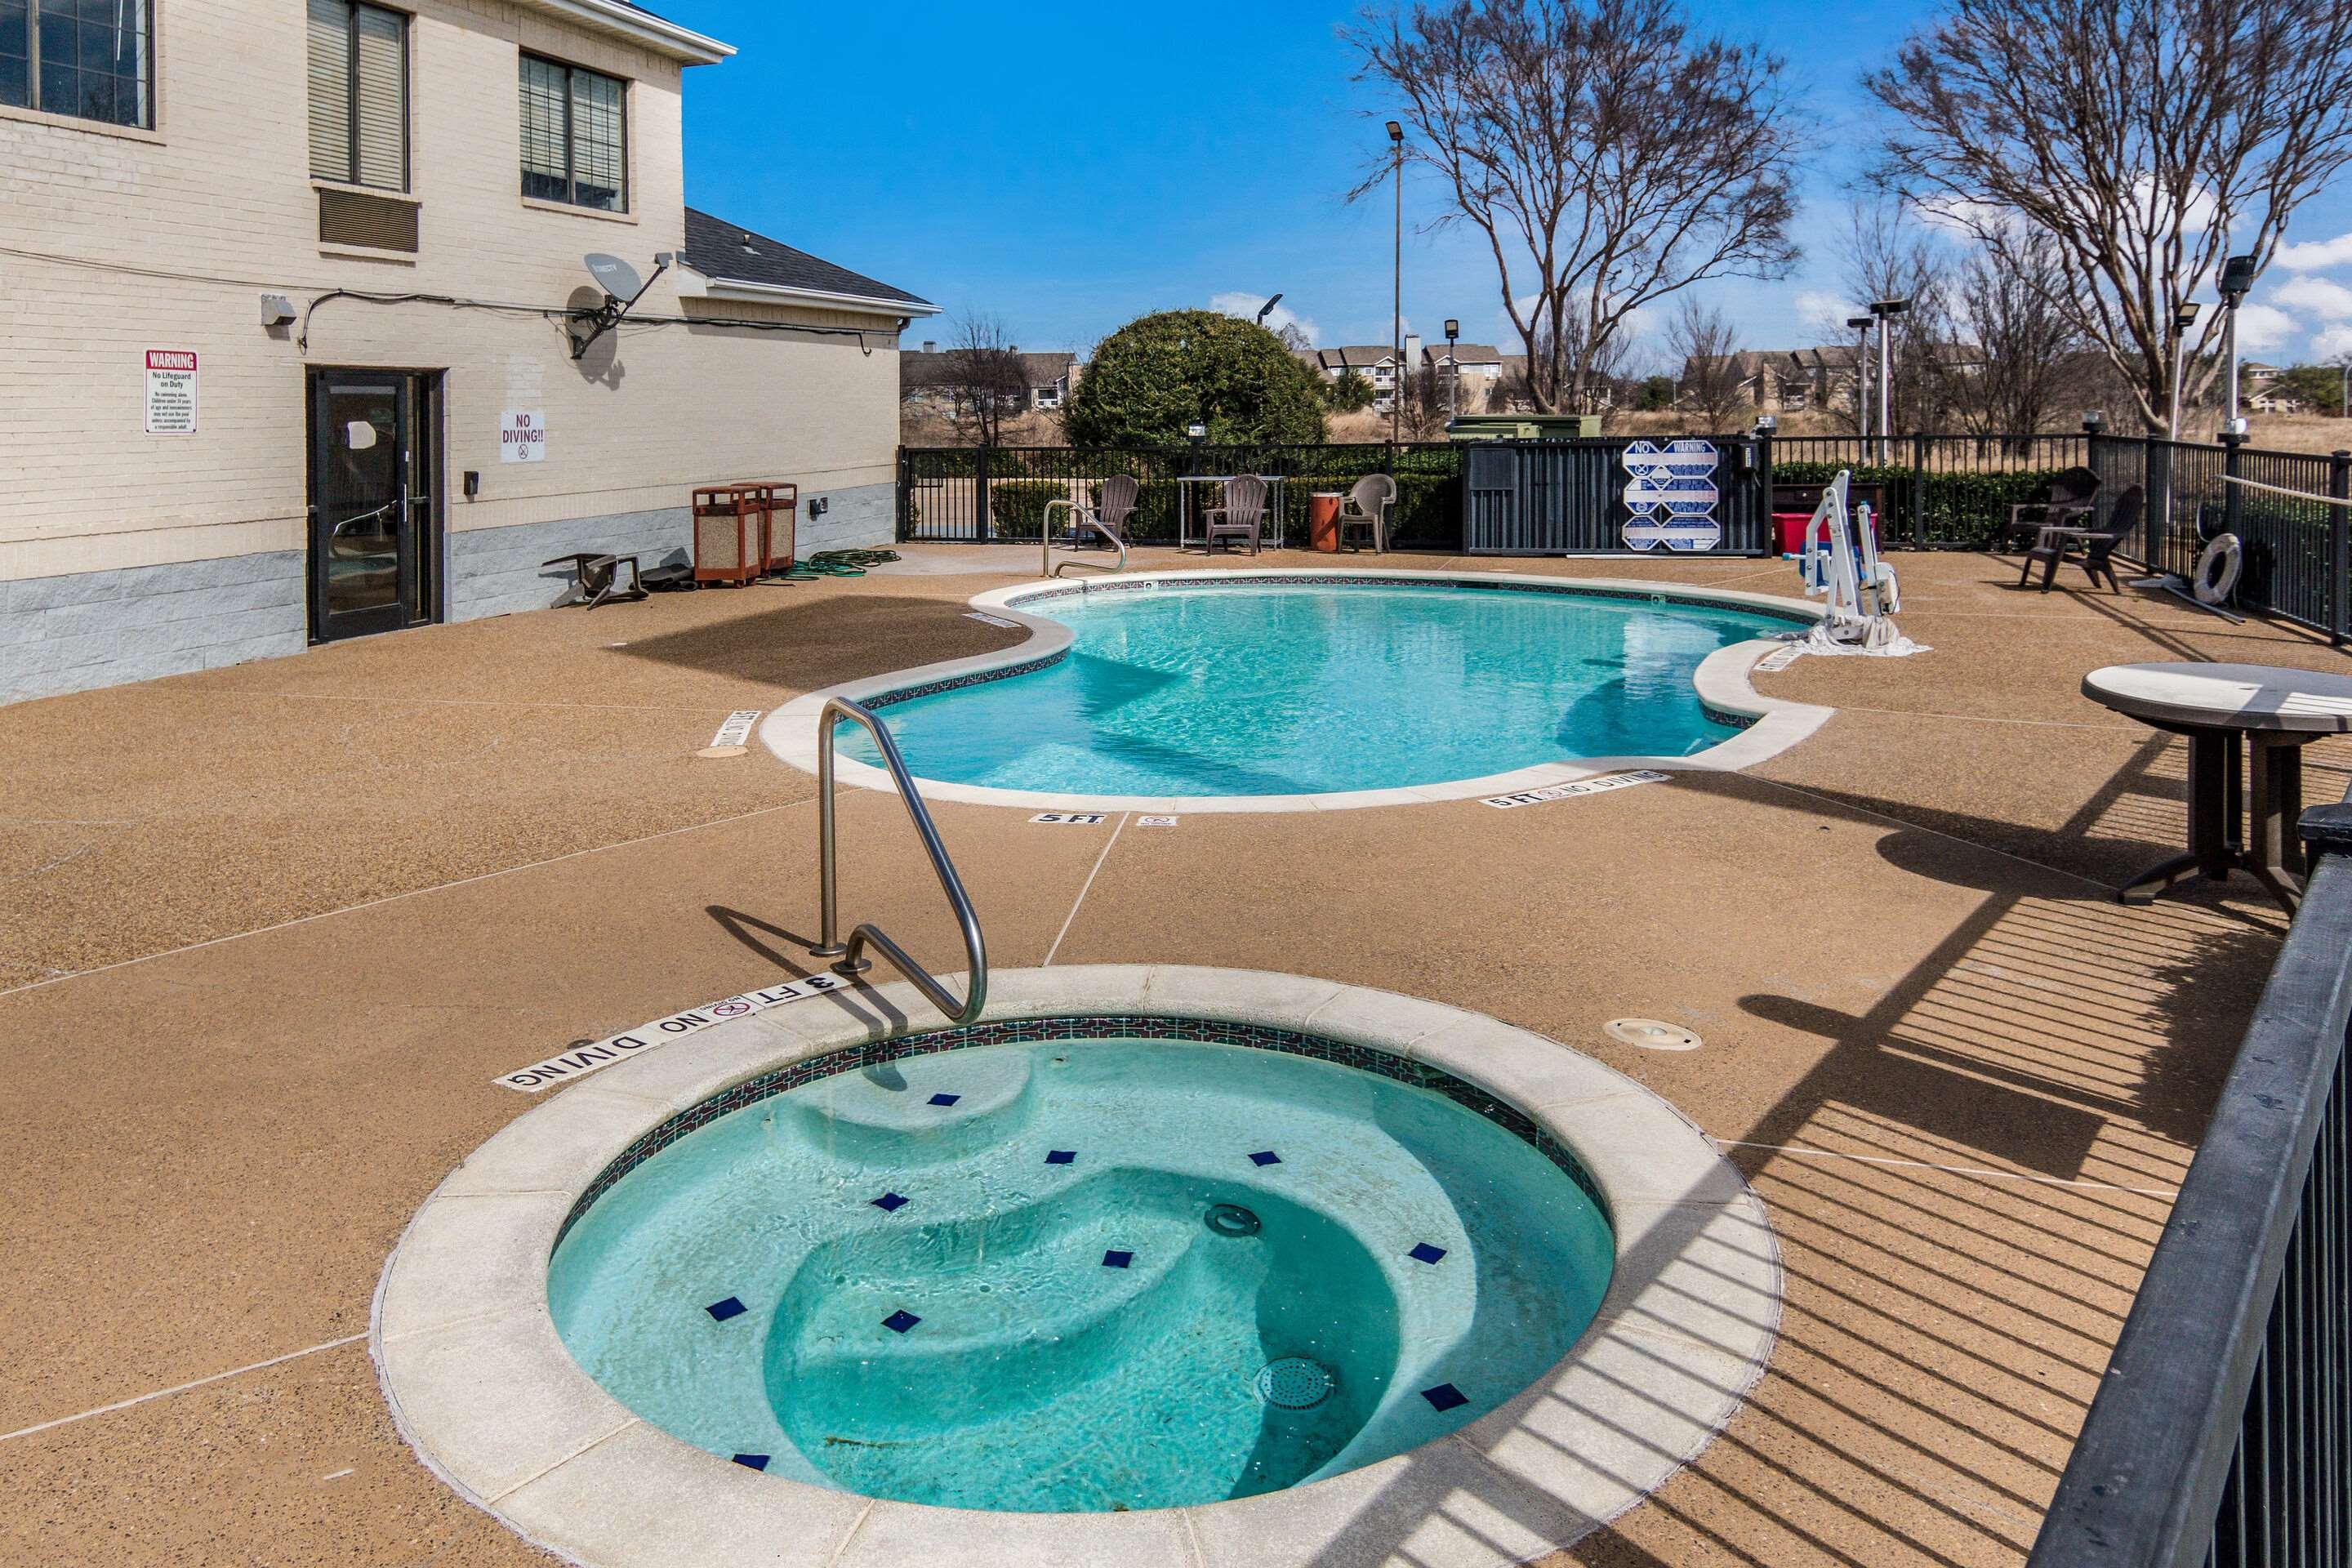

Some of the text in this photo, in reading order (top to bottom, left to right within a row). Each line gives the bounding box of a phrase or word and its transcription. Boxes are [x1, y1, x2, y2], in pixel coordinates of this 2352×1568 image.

[149, 352, 194, 368] WARNING
[163, 372, 191, 381] Lifeguard
[170, 381, 184, 390] Duty
[516, 414, 530, 427] NO
[503, 430, 543, 443] DIVING!!
[1635, 443, 1650, 453] NO
[1673, 442, 1706, 452] WARNING
[1560, 785, 1590, 794] NO
[1592, 772, 1664, 787] DIVING
[757, 977, 835, 1004] 3 FT
[699, 1000, 728, 1011] DIVING
[507, 1013, 710, 1086] NO DIVING
